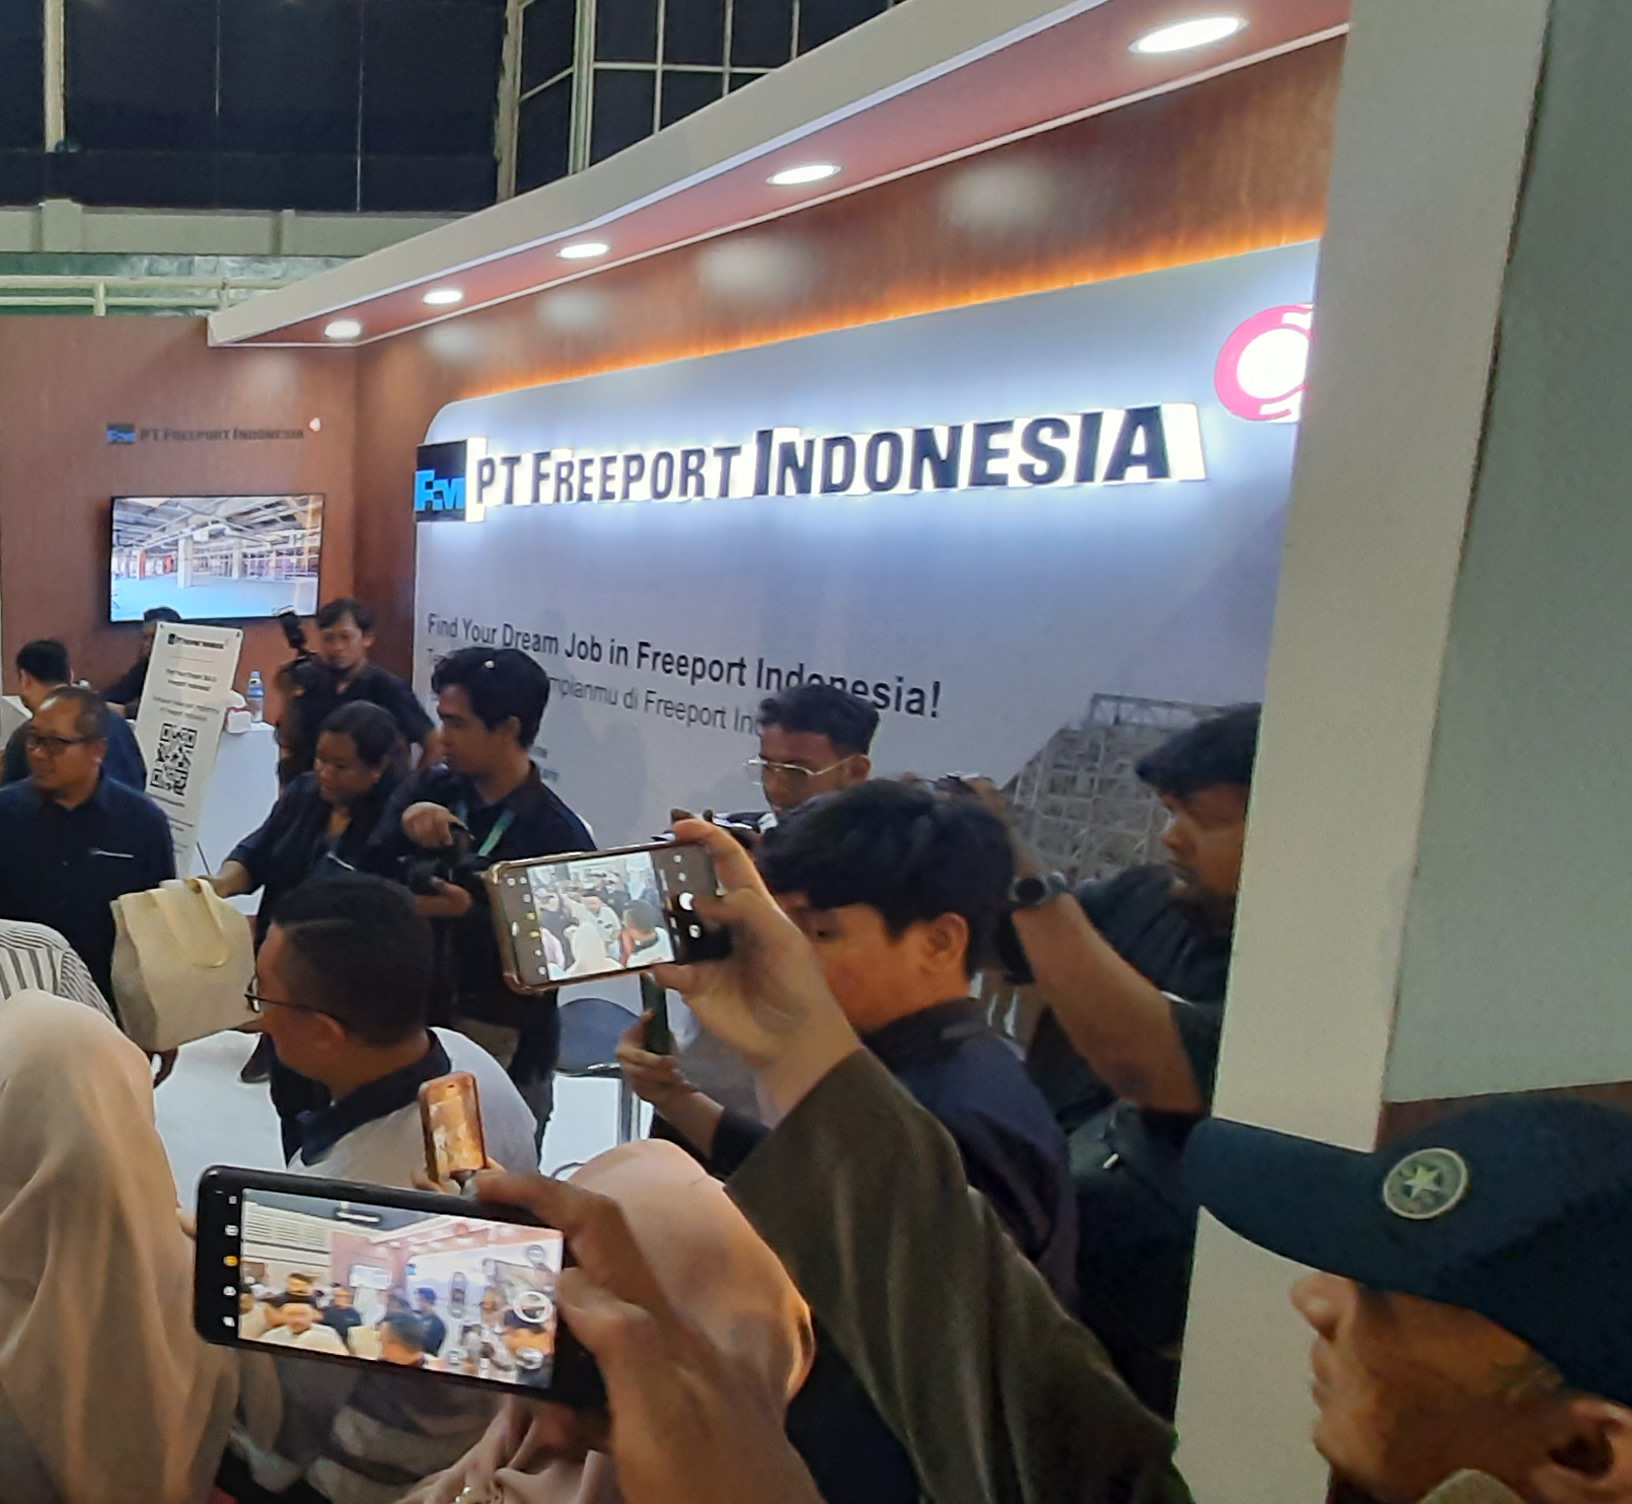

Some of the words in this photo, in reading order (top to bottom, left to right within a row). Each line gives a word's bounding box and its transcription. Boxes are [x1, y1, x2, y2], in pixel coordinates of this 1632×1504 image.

[475, 456, 522, 505] PT
[530, 446, 742, 504] FREEPORT
[753, 405, 1171, 497] INDONESIA
[428, 612, 459, 638] Find
[462, 618, 498, 645] Your
[503, 622, 559, 655] Dream
[565, 632, 602, 663] Job
[609, 638, 628, 667] in
[636, 641, 747, 686] Freeport
[547, 674, 619, 706] mpianmu
[645, 689, 727, 730] Freeport
